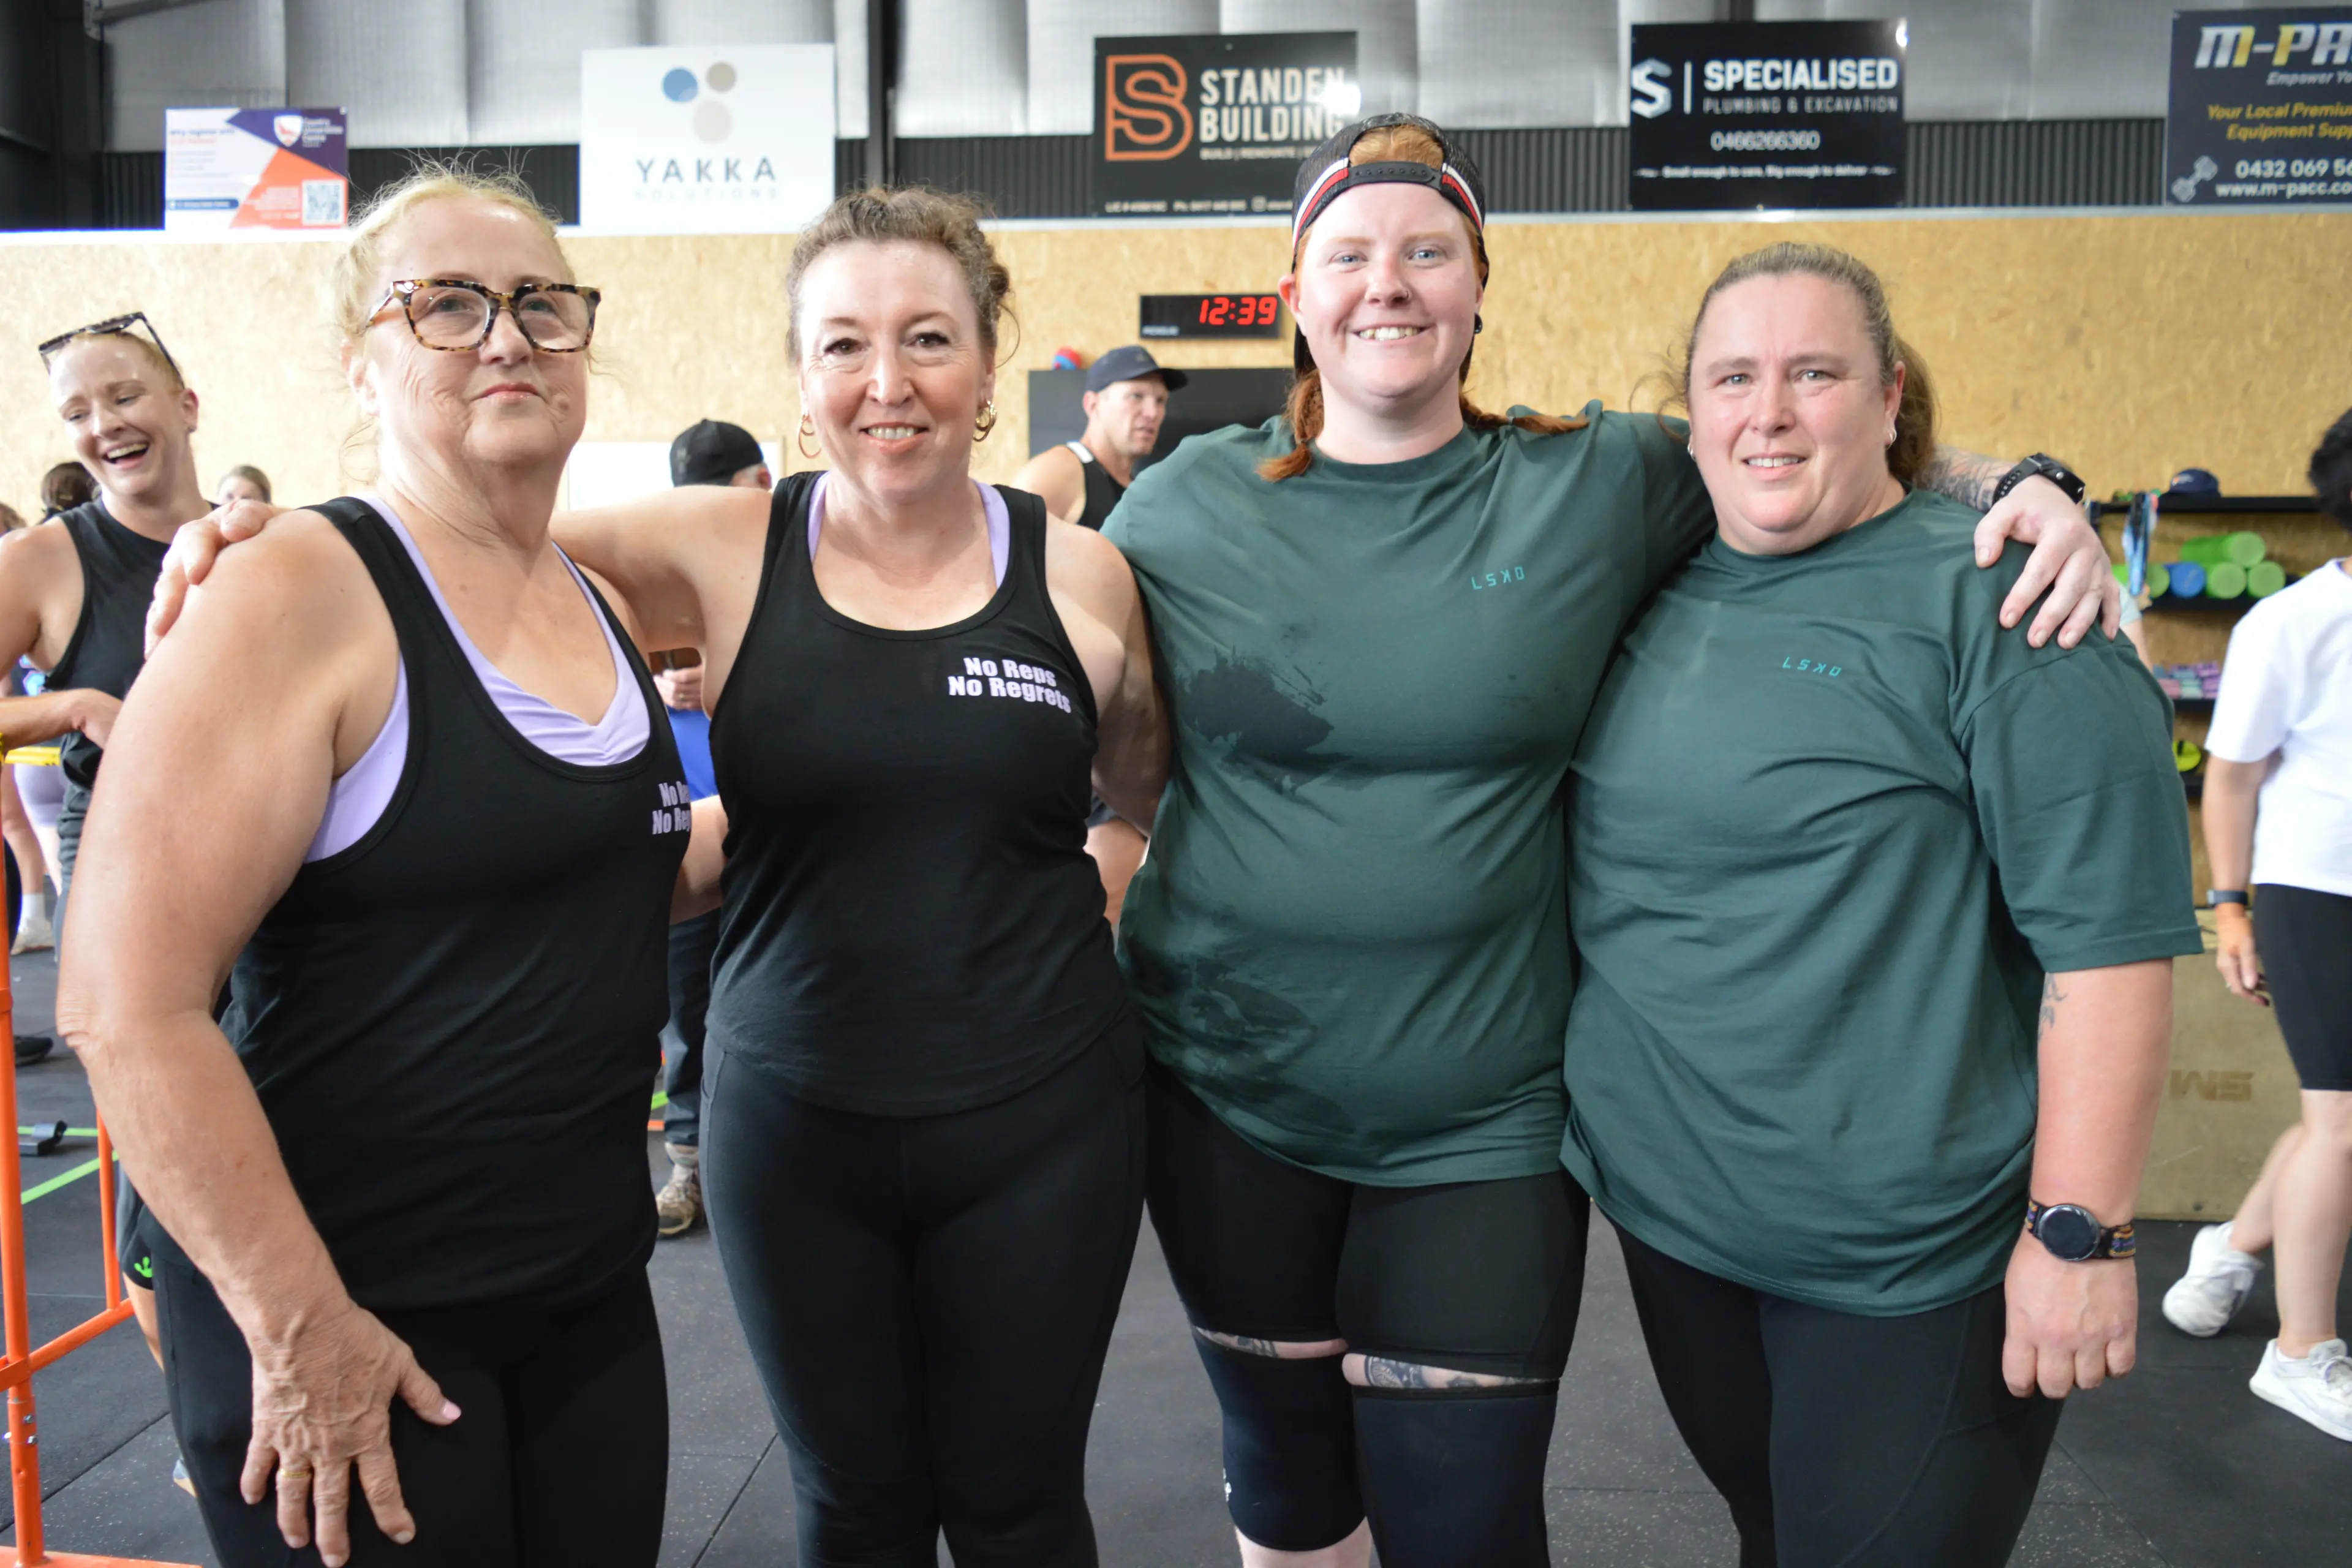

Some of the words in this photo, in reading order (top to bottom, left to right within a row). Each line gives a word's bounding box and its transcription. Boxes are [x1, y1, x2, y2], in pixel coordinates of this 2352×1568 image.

[2194, 23, 2352, 68] M-PA
[1199, 67, 1345, 105] STANDEN
[1703, 59, 1898, 91] SPECIALISED
[1703, 96, 1781, 115] PLUMBING
[1804, 94, 1898, 113] EXCAVATION
[2207, 104, 2242, 120] Your
[2245, 103, 2290, 119] Local
[1199, 105, 1344, 143] BUILDING
[2226, 123, 2315, 143] Equipment
[636, 157, 777, 184] YAKKA
[2236, 160, 2287, 178] 0432
[2290, 159, 2329, 178] 069
[1199, 296, 1278, 325] 12:39
[963, 657, 998, 676] No
[948, 676, 982, 696] No
[989, 677, 1071, 713] Regrets
[658, 782, 679, 807] No
[652, 809, 672, 835] No
